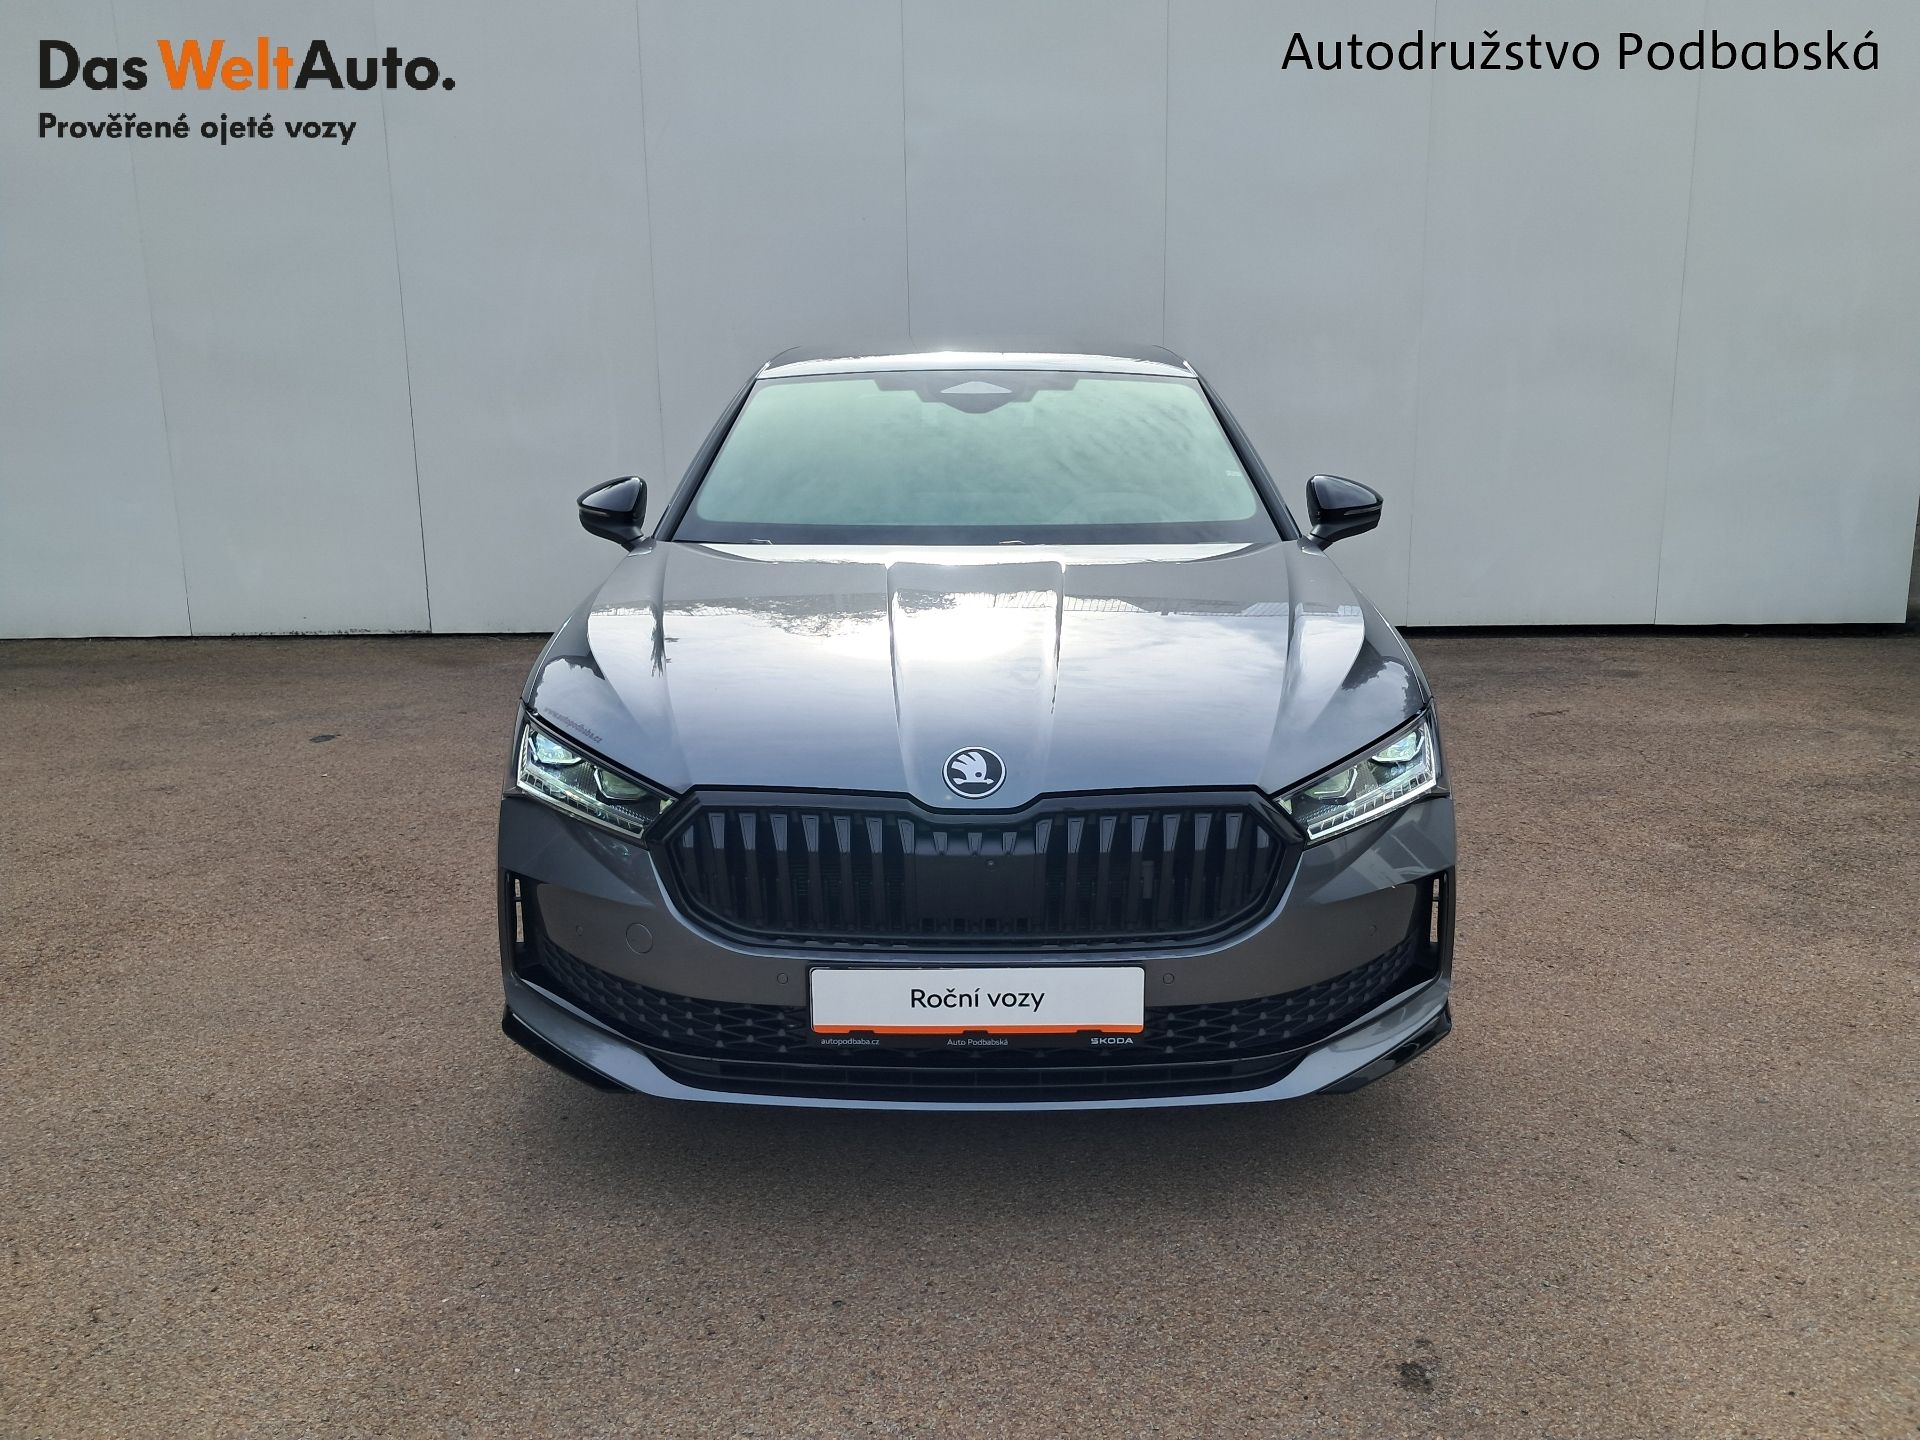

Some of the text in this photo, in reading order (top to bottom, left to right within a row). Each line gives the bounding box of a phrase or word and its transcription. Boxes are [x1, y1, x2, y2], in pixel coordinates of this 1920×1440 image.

[910, 987, 1045, 1012] Roční vozy
[820, 1038, 880, 1046] autopodbaba.cz
[946, 1038, 1009, 1046] Auto Podbabská
